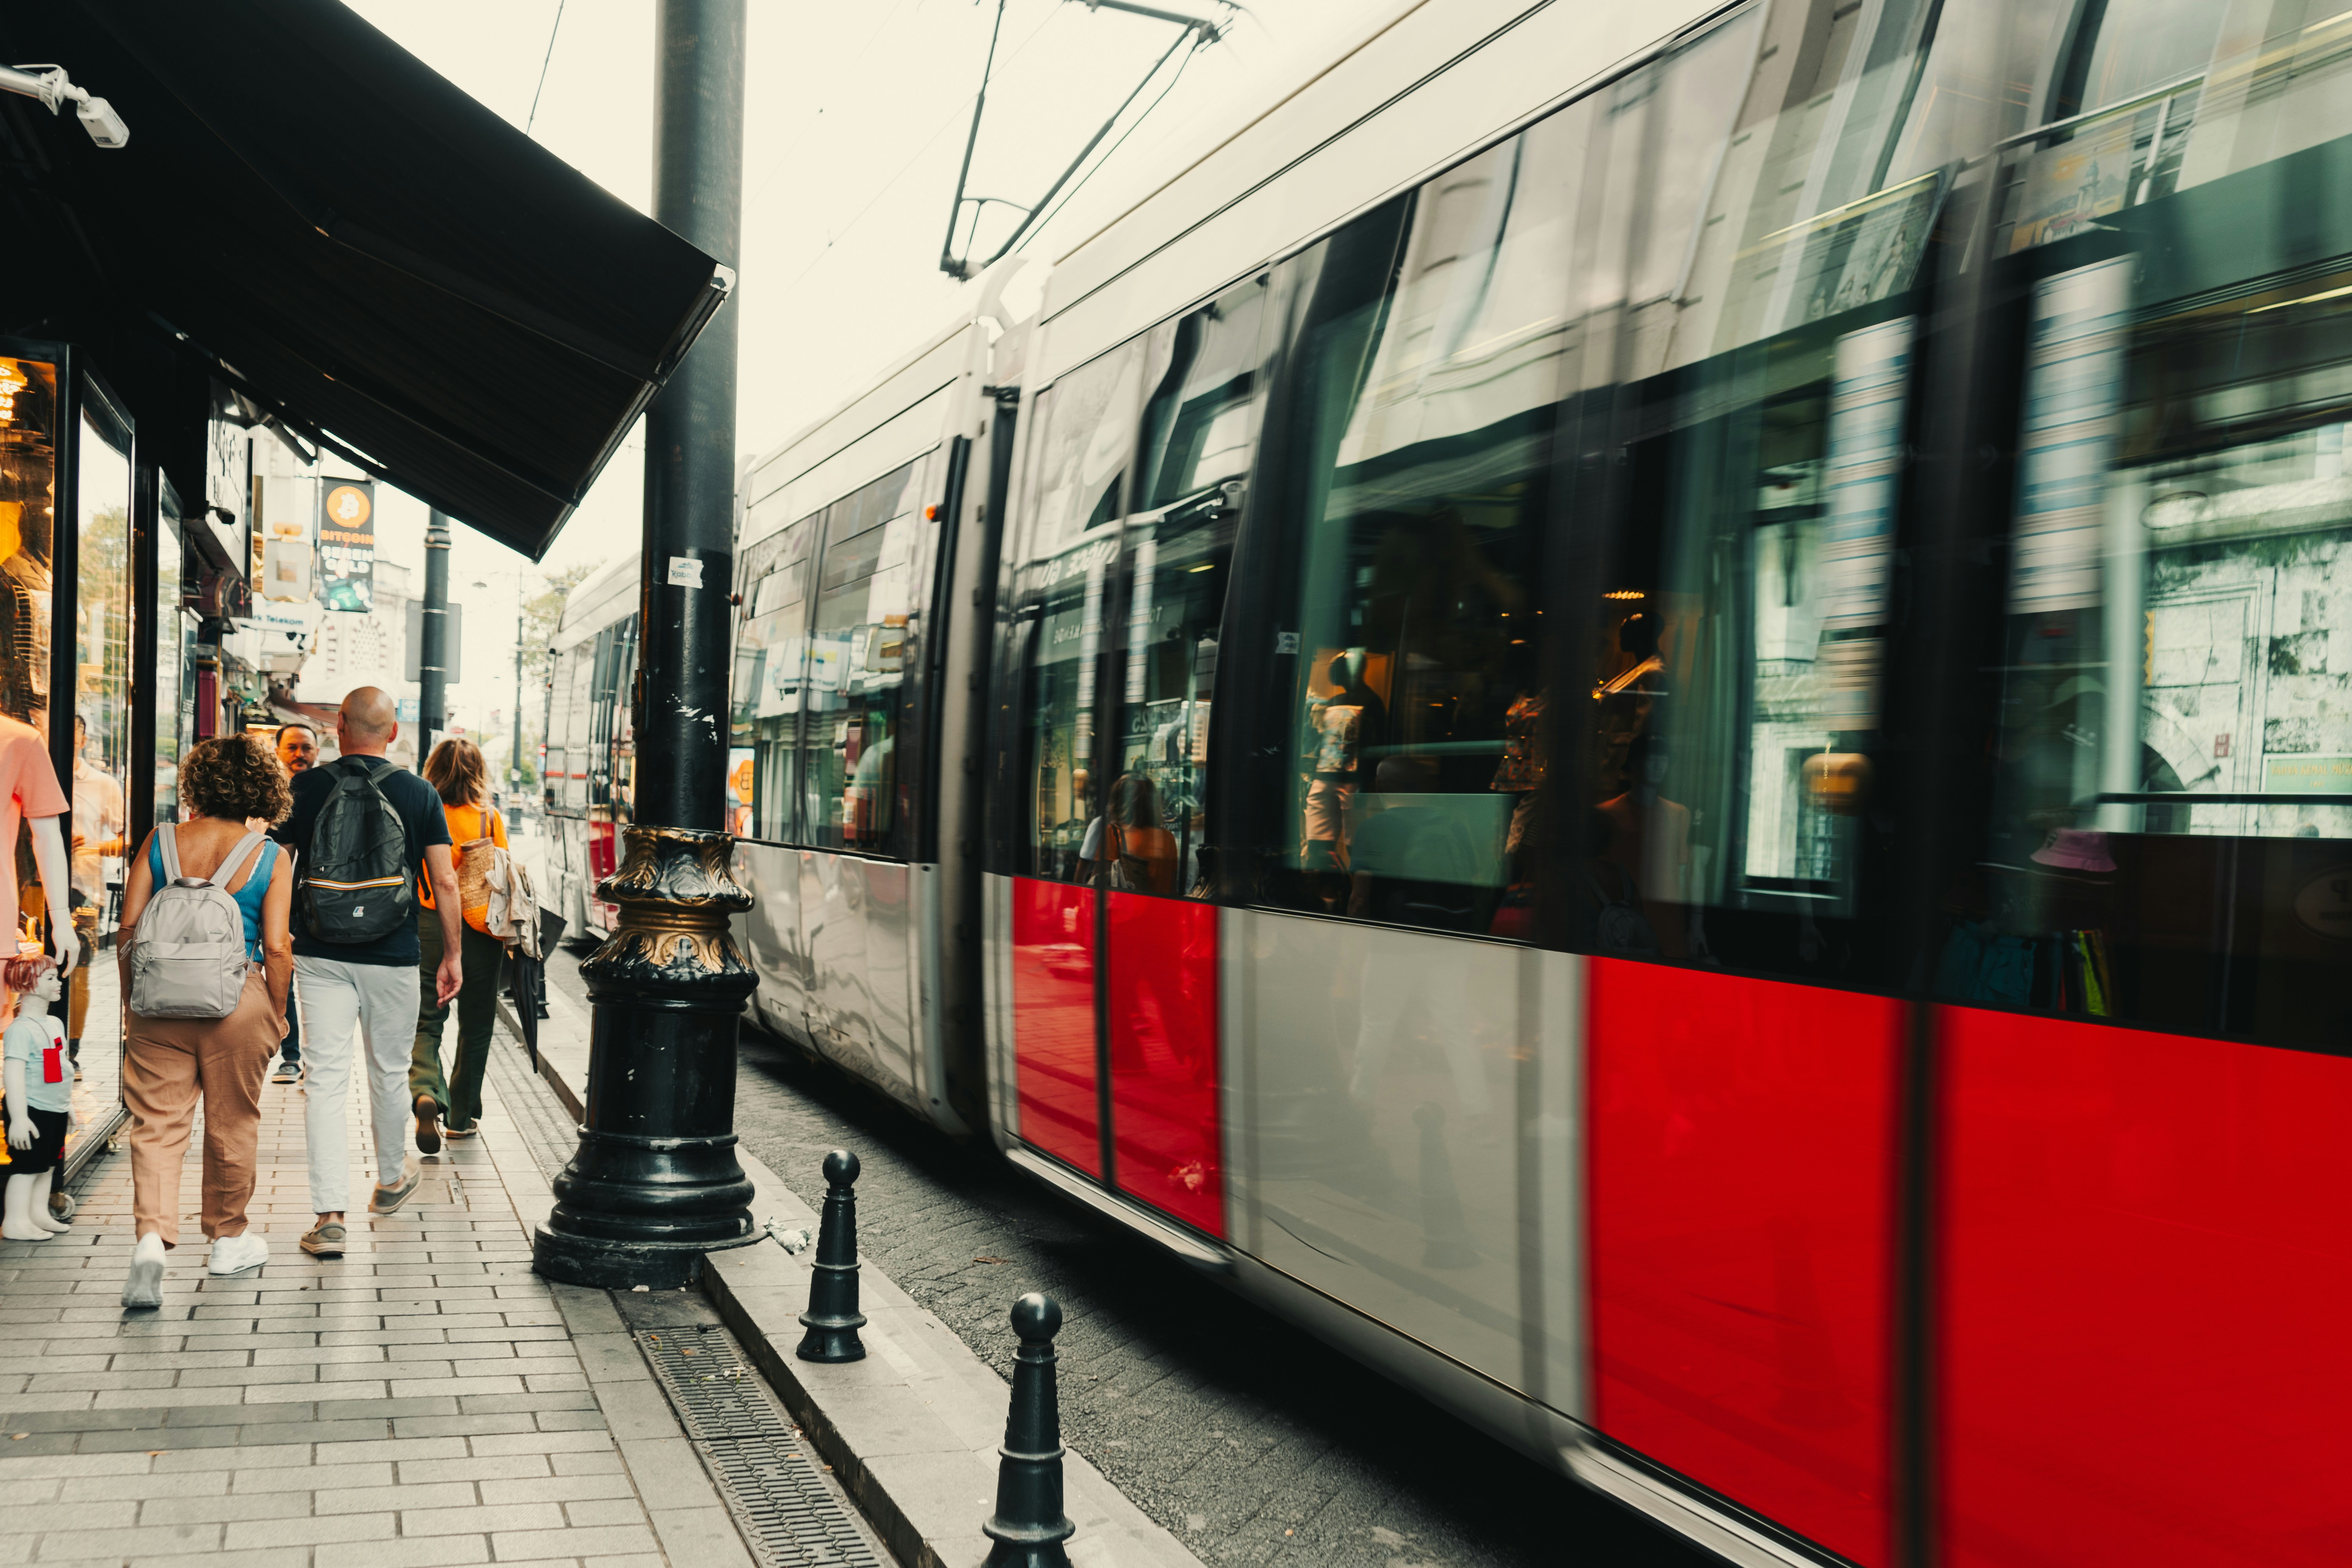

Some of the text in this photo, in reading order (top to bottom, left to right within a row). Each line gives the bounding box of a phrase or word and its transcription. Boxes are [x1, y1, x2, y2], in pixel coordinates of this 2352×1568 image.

[321, 529, 374, 545] BITCOIN
[325, 558, 370, 573] GLD
[267, 615, 303, 625] Telekom
[2271, 765, 2298, 776] YAHYA
[2300, 764, 2329, 775] KEMAL
